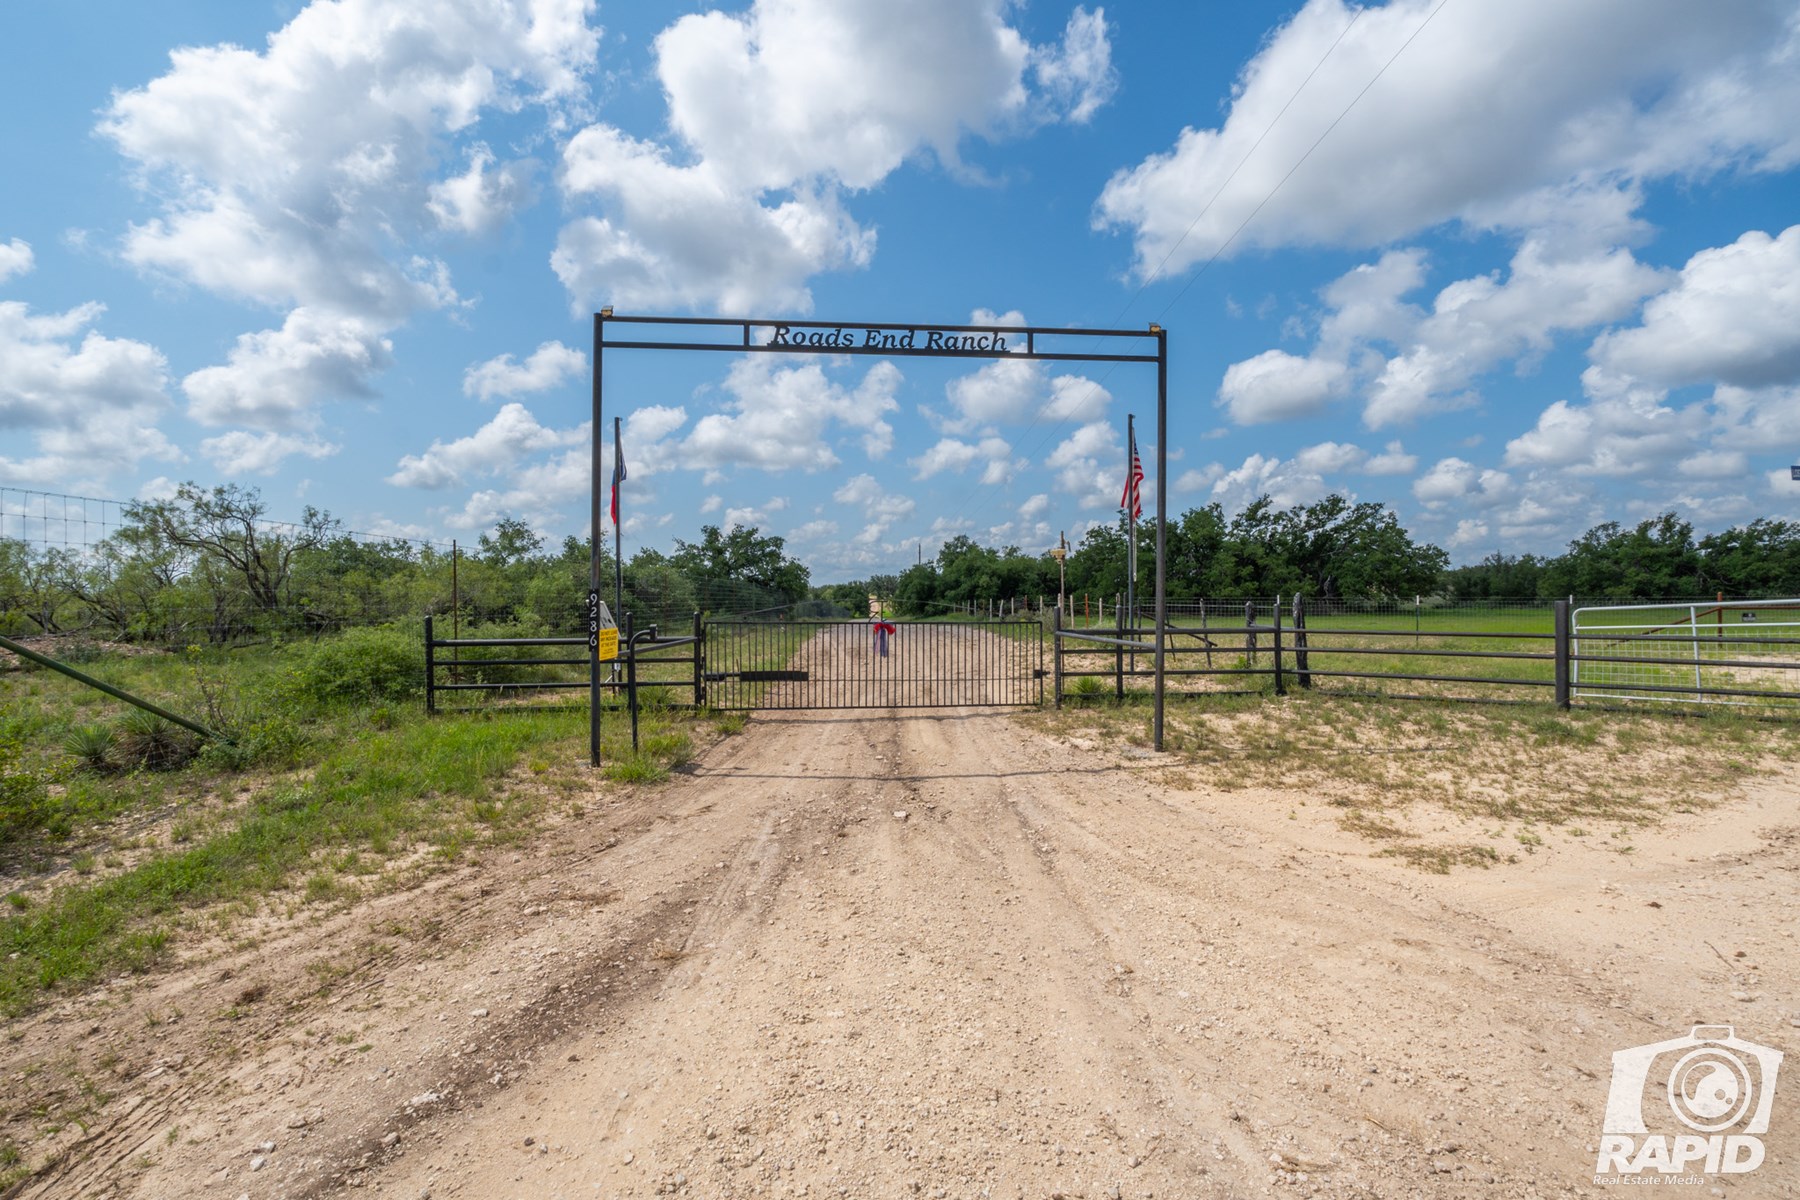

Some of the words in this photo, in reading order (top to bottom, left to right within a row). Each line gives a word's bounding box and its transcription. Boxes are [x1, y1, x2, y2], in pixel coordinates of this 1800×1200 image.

[773, 325, 855, 348] Roads
[862, 329, 915, 350] End
[924, 331, 1008, 351] Ranch
